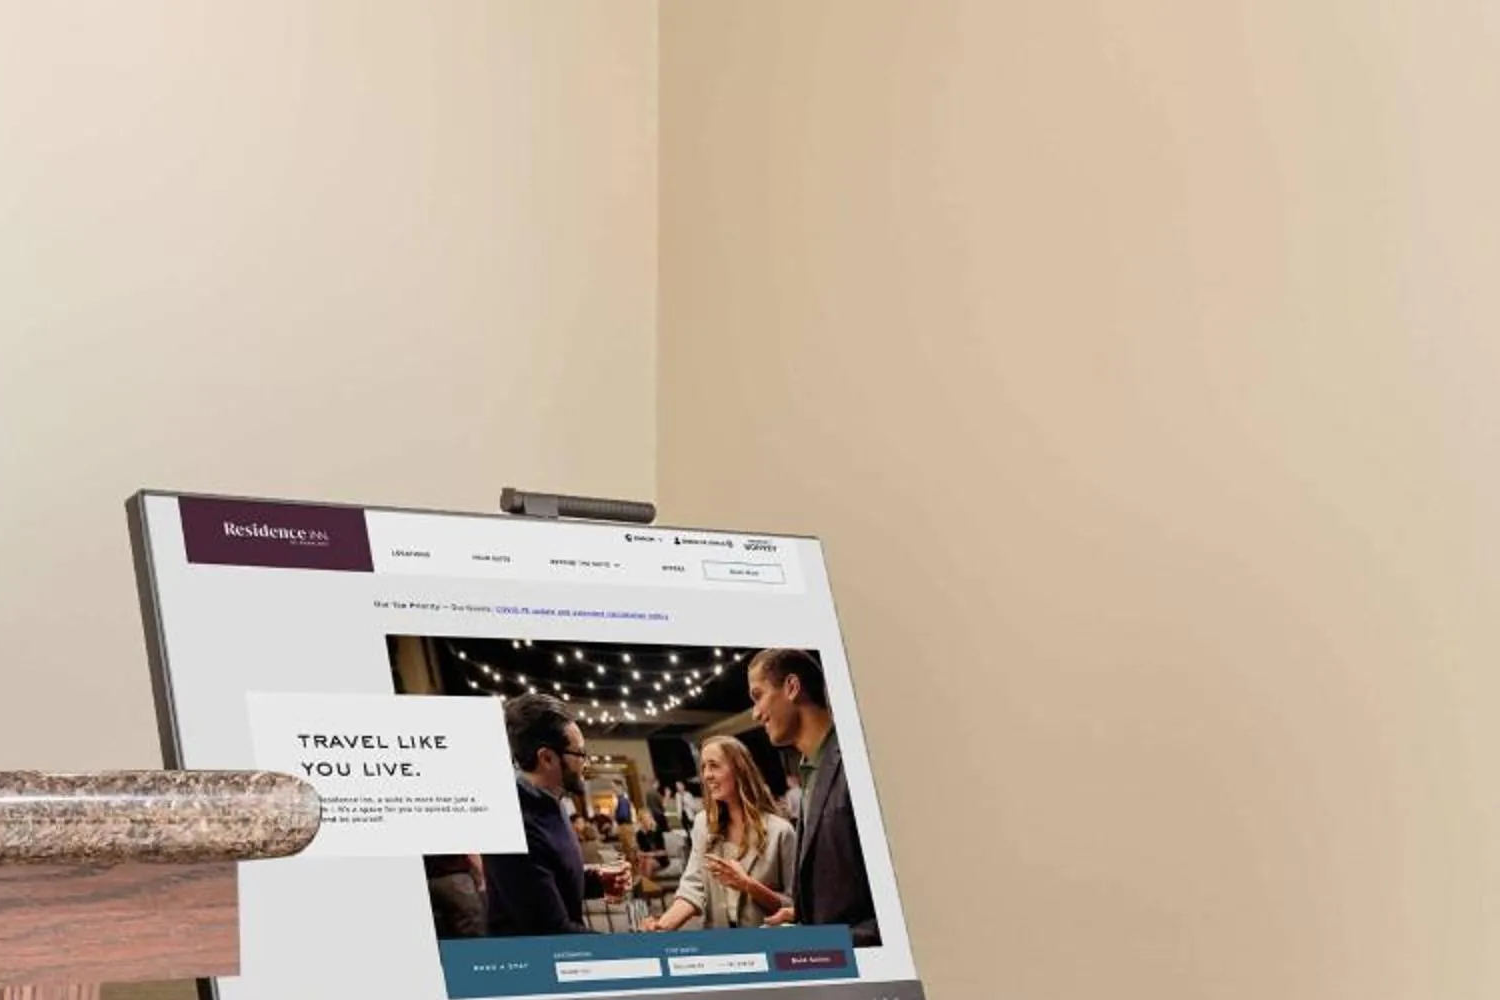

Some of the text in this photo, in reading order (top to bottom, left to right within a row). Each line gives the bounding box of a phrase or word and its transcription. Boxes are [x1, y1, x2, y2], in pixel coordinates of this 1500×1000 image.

[223, 521, 307, 540] Residence
[298, 735, 448, 749] TRAVEL LIKE
[301, 762, 421, 777] YOU LIVE.
